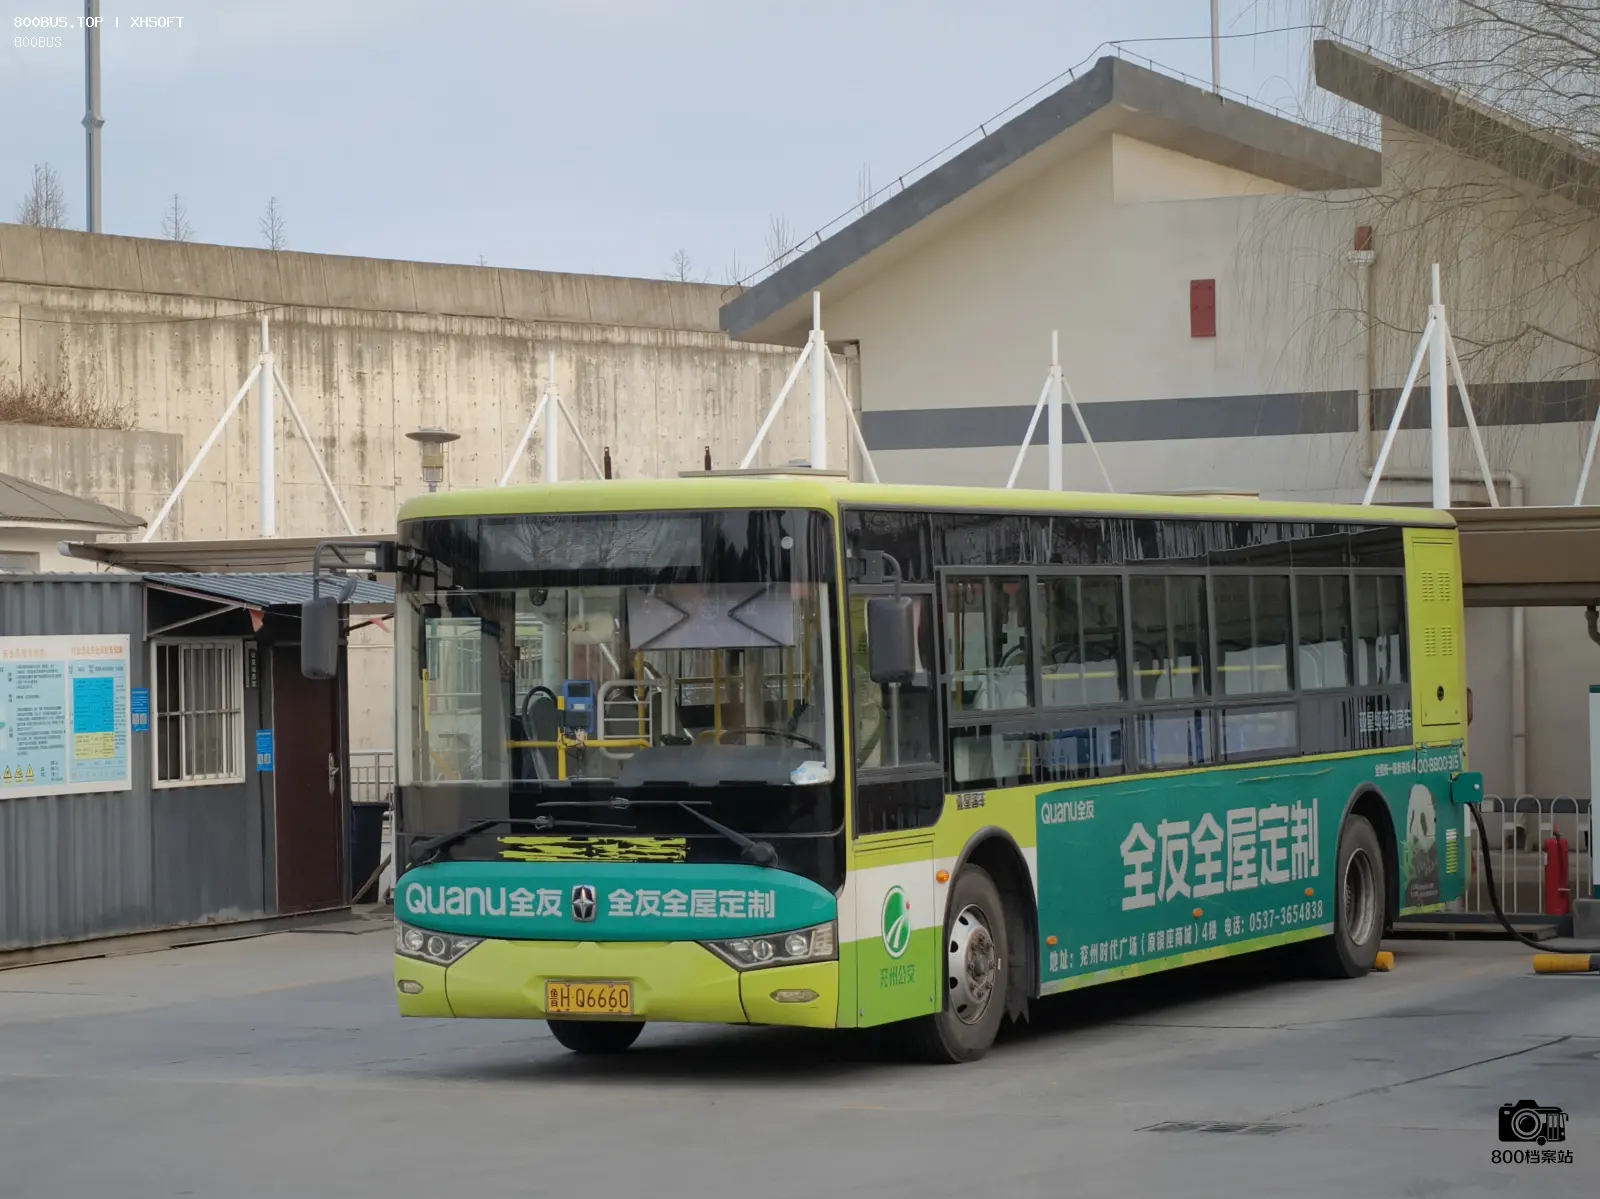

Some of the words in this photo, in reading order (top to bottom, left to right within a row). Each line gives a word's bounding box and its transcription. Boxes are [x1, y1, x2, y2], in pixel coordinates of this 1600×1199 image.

[1119, 798, 1320, 912] 全友全屋定制
[607, 888, 776, 919] 全友全屋定制
